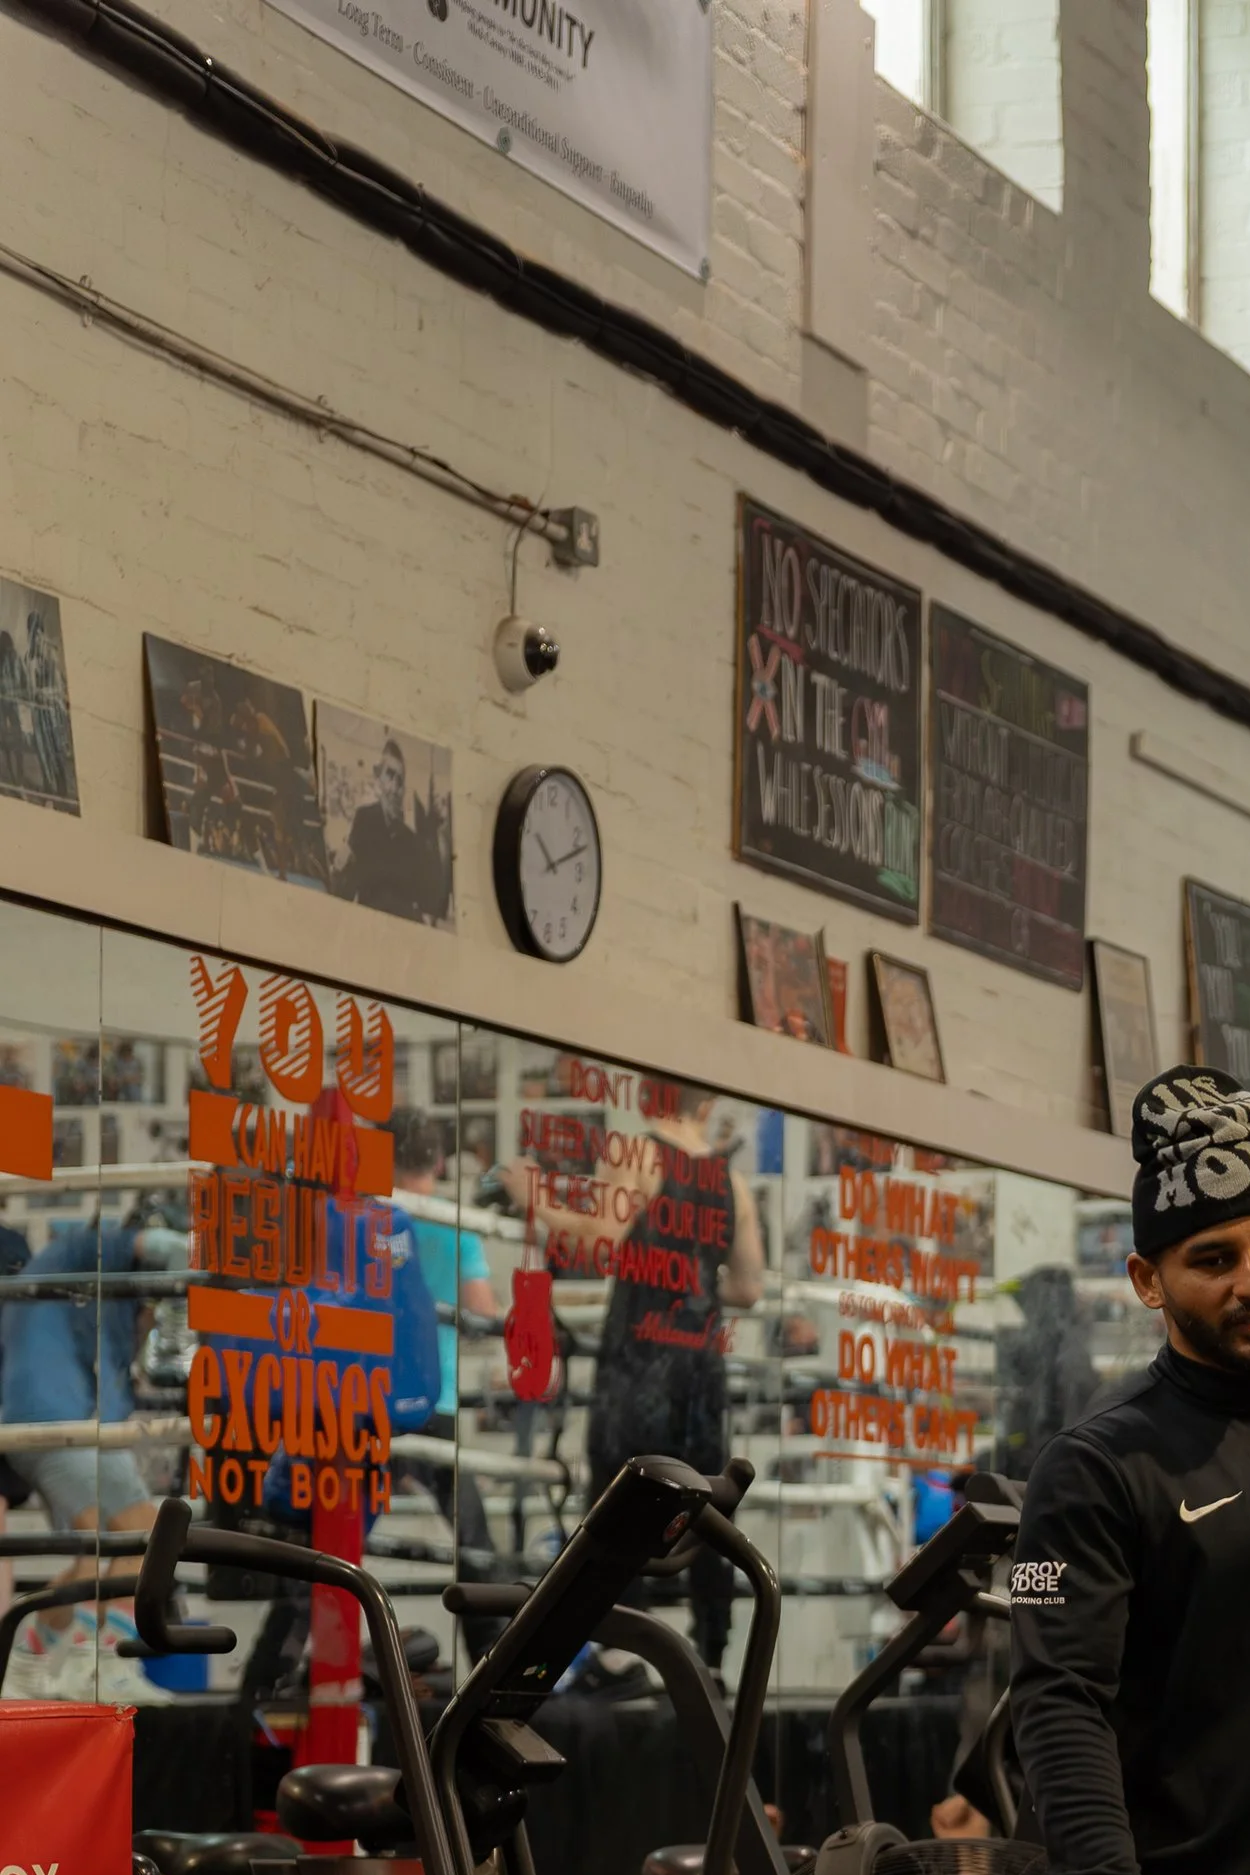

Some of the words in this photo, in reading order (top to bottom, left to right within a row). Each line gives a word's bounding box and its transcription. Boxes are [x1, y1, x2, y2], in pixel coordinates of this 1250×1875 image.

[760, 532, 799, 641] NO
[805, 556, 911, 694] SPECTATORS
[810, 671, 849, 761] THE
[757, 740, 811, 836] WHILE
[190, 955, 394, 1123] YOU
[571, 1059, 634, 1112] DON'T
[236, 1101, 287, 1173] CAN
[520, 1108, 585, 1161] SUFFER
[589, 1127, 648, 1172] NOW
[650, 1141, 694, 1186] AND
[698, 1152, 729, 1197] LIVE
[188, 1167, 393, 1299] RESULTS
[525, 1165, 562, 1210] THE
[613, 1186, 648, 1223] OF
[644, 1195, 694, 1240] YOUR
[699, 1206, 729, 1249] LIFE
[839, 1164, 877, 1226] DO
[886, 1175, 960, 1246] WHAT
[544, 1229, 570, 1270] AS
[573, 1235, 590, 1276] A
[810, 1226, 905, 1289] OTHERS
[910, 1249, 981, 1305] WON'T
[276, 1288, 312, 1355] OR
[838, 1327, 876, 1385] DO
[886, 1339, 957, 1399] WHAT
[188, 1344, 392, 1464] excuses
[810, 1387, 905, 1450] OTHERS
[912, 1403, 979, 1457] CAN'T
[188, 1455, 269, 1507] NOT
[290, 1462, 391, 1516] BOTH
[1011, 1596, 1042, 1605] BOXING
[1043, 1596, 1066, 1605] CLUB
